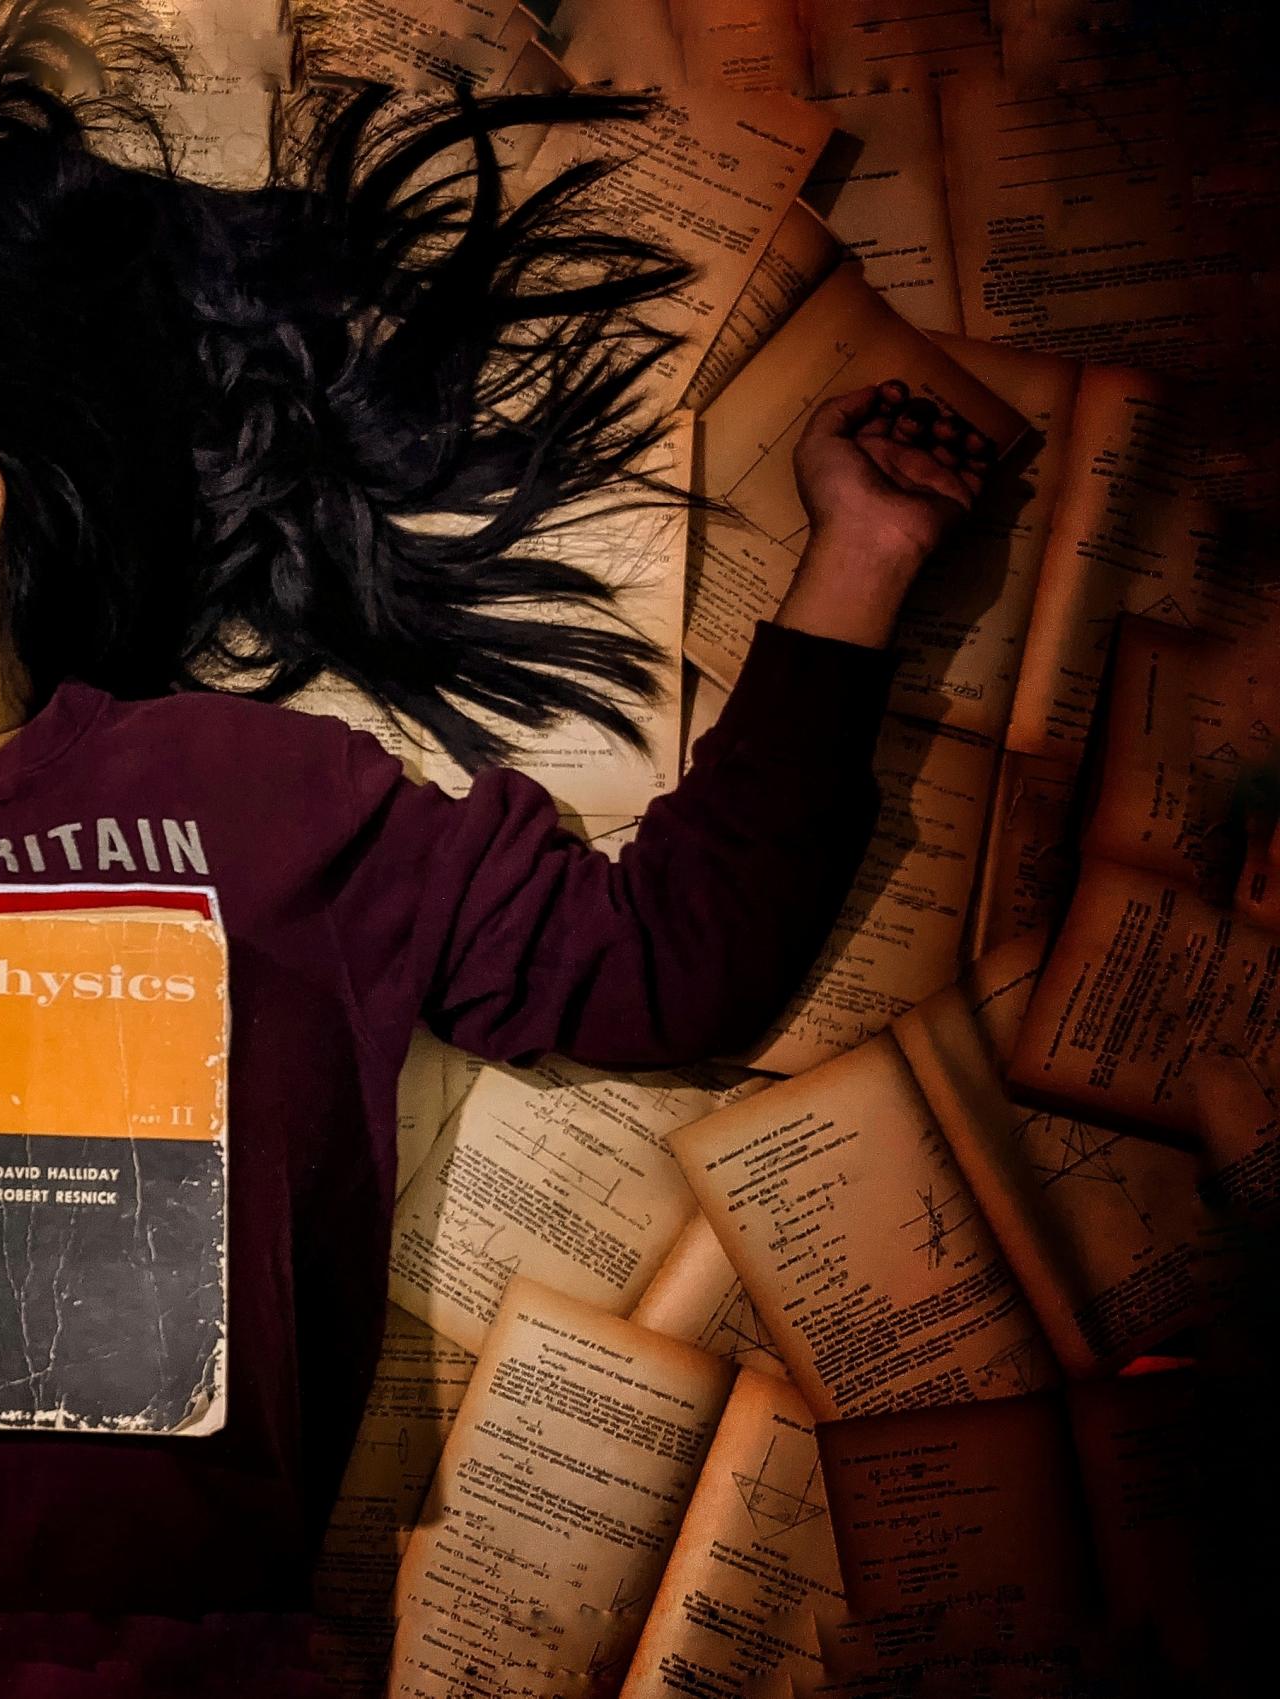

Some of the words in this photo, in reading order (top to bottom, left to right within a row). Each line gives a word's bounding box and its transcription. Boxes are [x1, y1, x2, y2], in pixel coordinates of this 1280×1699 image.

[131, 1114, 161, 1124] PART
[170, 1106, 193, 1126] II
[47, 1166, 120, 1181] HALLIDAY
[55, 1189, 117, 1204] RESNICK
